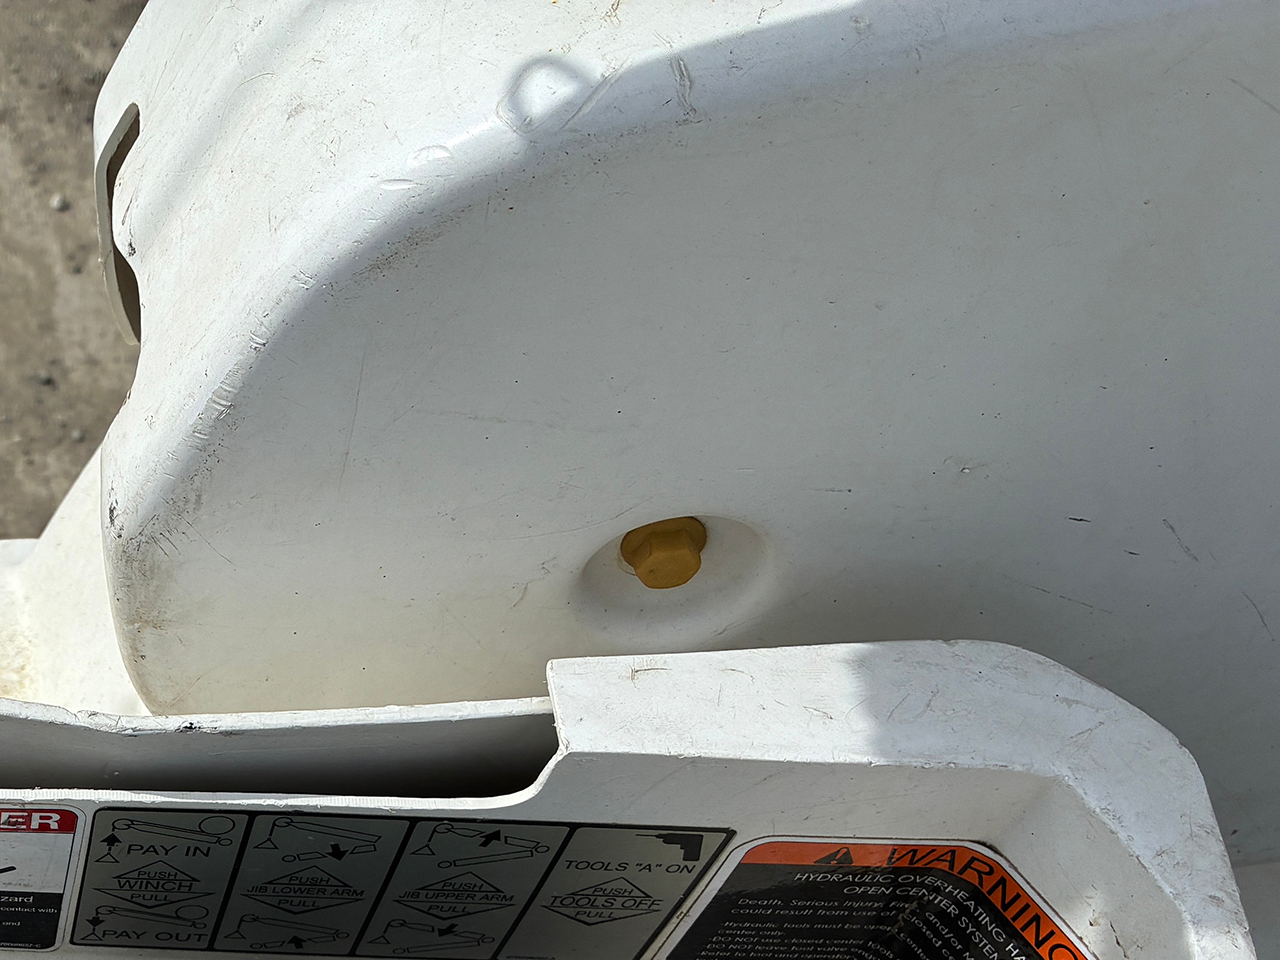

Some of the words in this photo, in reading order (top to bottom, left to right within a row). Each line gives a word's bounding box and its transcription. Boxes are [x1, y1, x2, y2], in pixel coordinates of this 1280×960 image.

[126, 844, 178, 856] PAY
[184, 846, 211, 857] IN
[565, 860, 630, 872] TOOLS
[636, 863, 662, 873] "A"
[666, 863, 696, 874] ON
[136, 870, 178, 880] PUSH
[288, 876, 330, 885] PUSH
[117, 880, 193, 892] WINCH
[441, 882, 484, 891] PUSH
[272, 887, 327, 896] LOWER
[330, 888, 365, 897] ARM
[592, 887, 633, 896] PUSH
[130, 893, 170, 902] PULL
[424, 892, 479, 901] UPPER
[479, 894, 514, 902] ARM
[550, 896, 618, 907] TOOLS
[621, 899, 664, 908] OFF
[843, 886, 893, 896] OPEN
[896, 886, 959, 917] CENTER
[277, 899, 320, 908] PULL
[794, 873, 895, 883] HYDRAULIC
[898, 874, 1007, 943] OVERHEATING
[427, 904, 470, 914] PULL
[574, 910, 615, 919] PULL
[789, 899, 839, 907] Serious
[925, 912, 963, 950] and/or
[102, 929, 148, 940] PAY
[154, 932, 208, 942] OUT
[867, 940, 894, 959] tools
